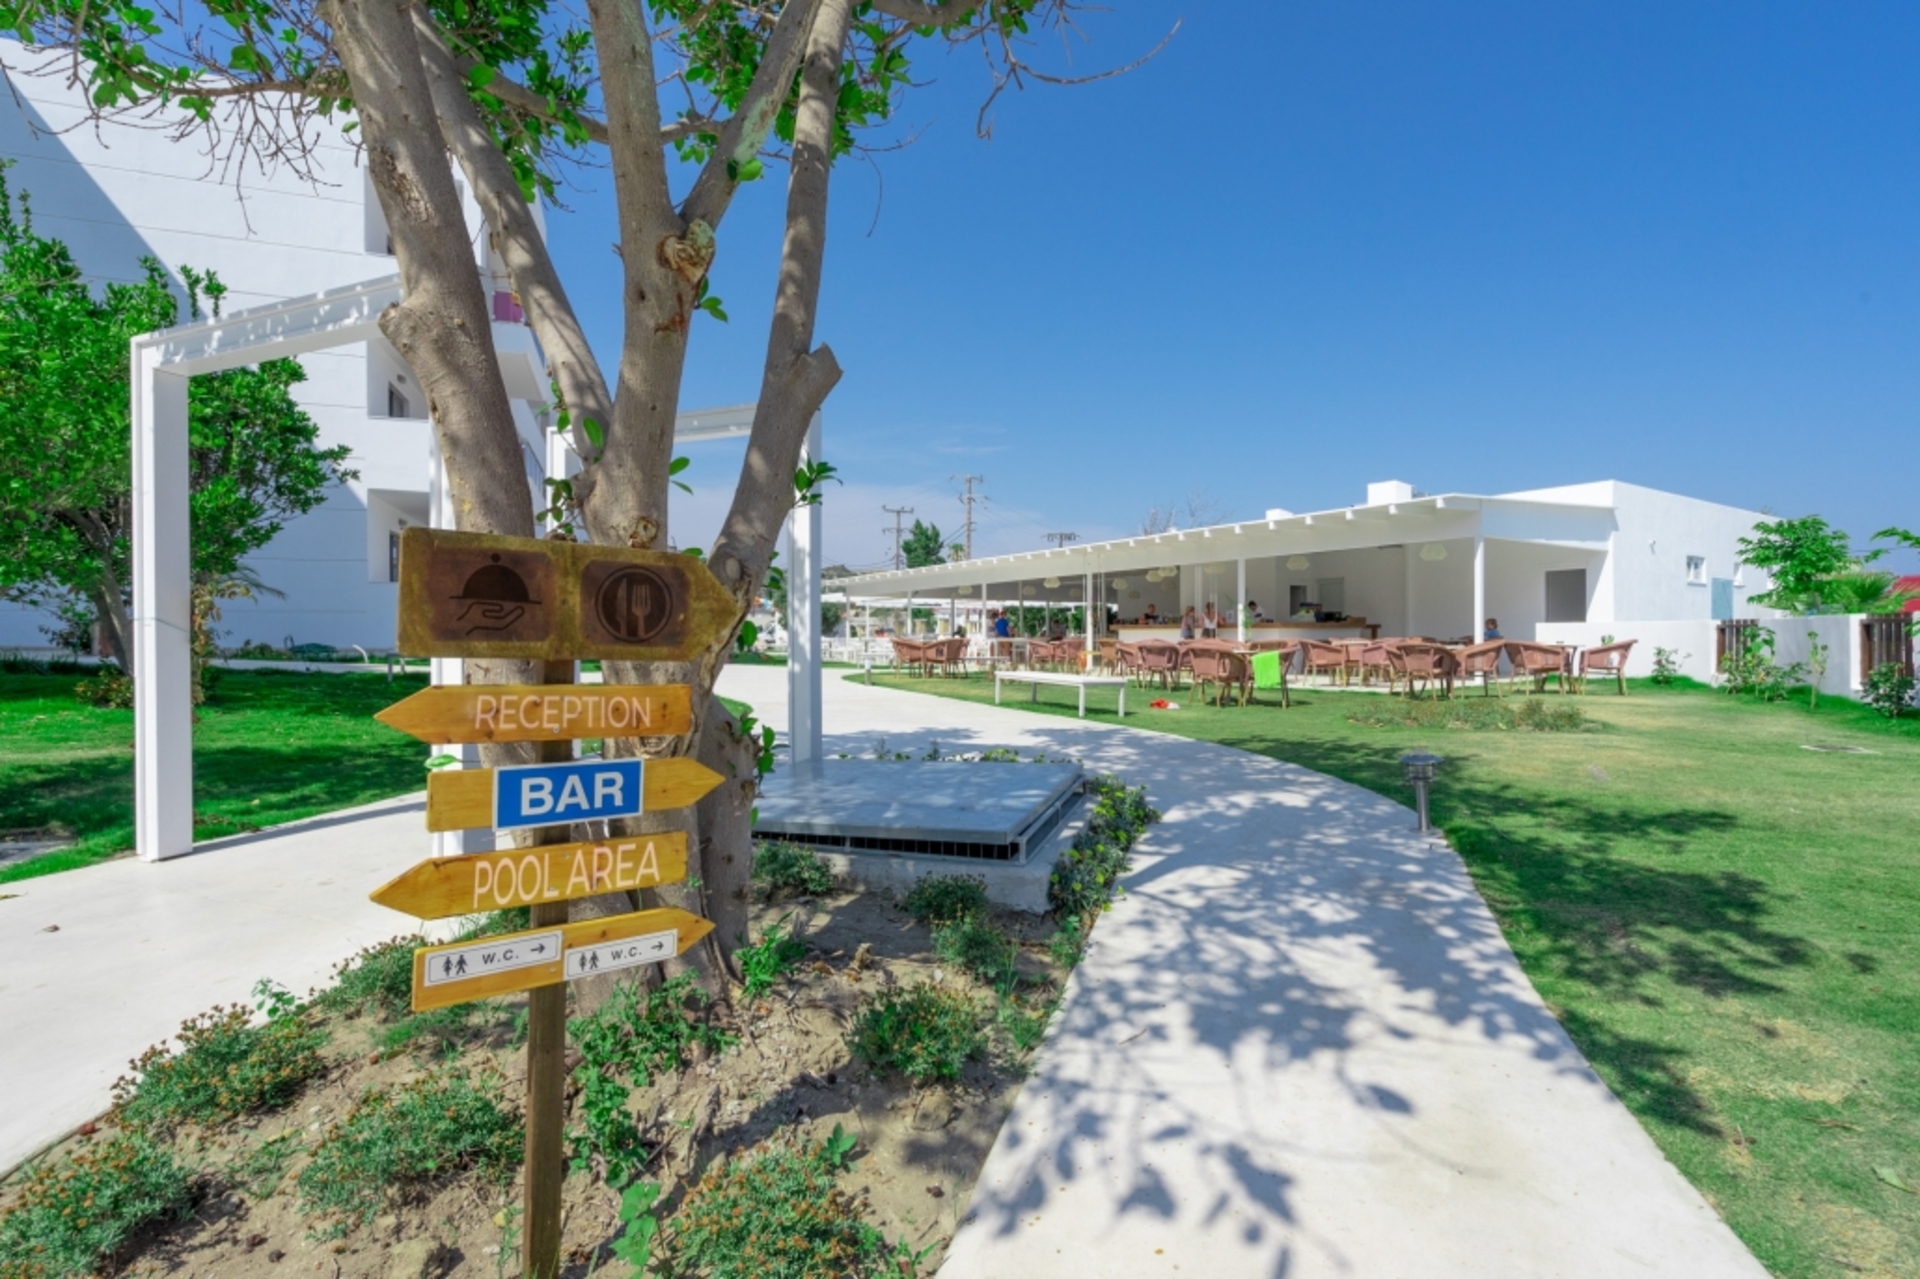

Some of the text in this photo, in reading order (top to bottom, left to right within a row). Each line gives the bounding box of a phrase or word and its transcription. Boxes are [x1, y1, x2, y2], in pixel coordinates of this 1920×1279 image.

[474, 695, 651, 730] RECEPTION
[521, 771, 624, 817] BAR
[473, 841, 660, 909] POOL AREA
[481, 949, 519, 965] W.C.
[611, 947, 642, 962] W.C.
